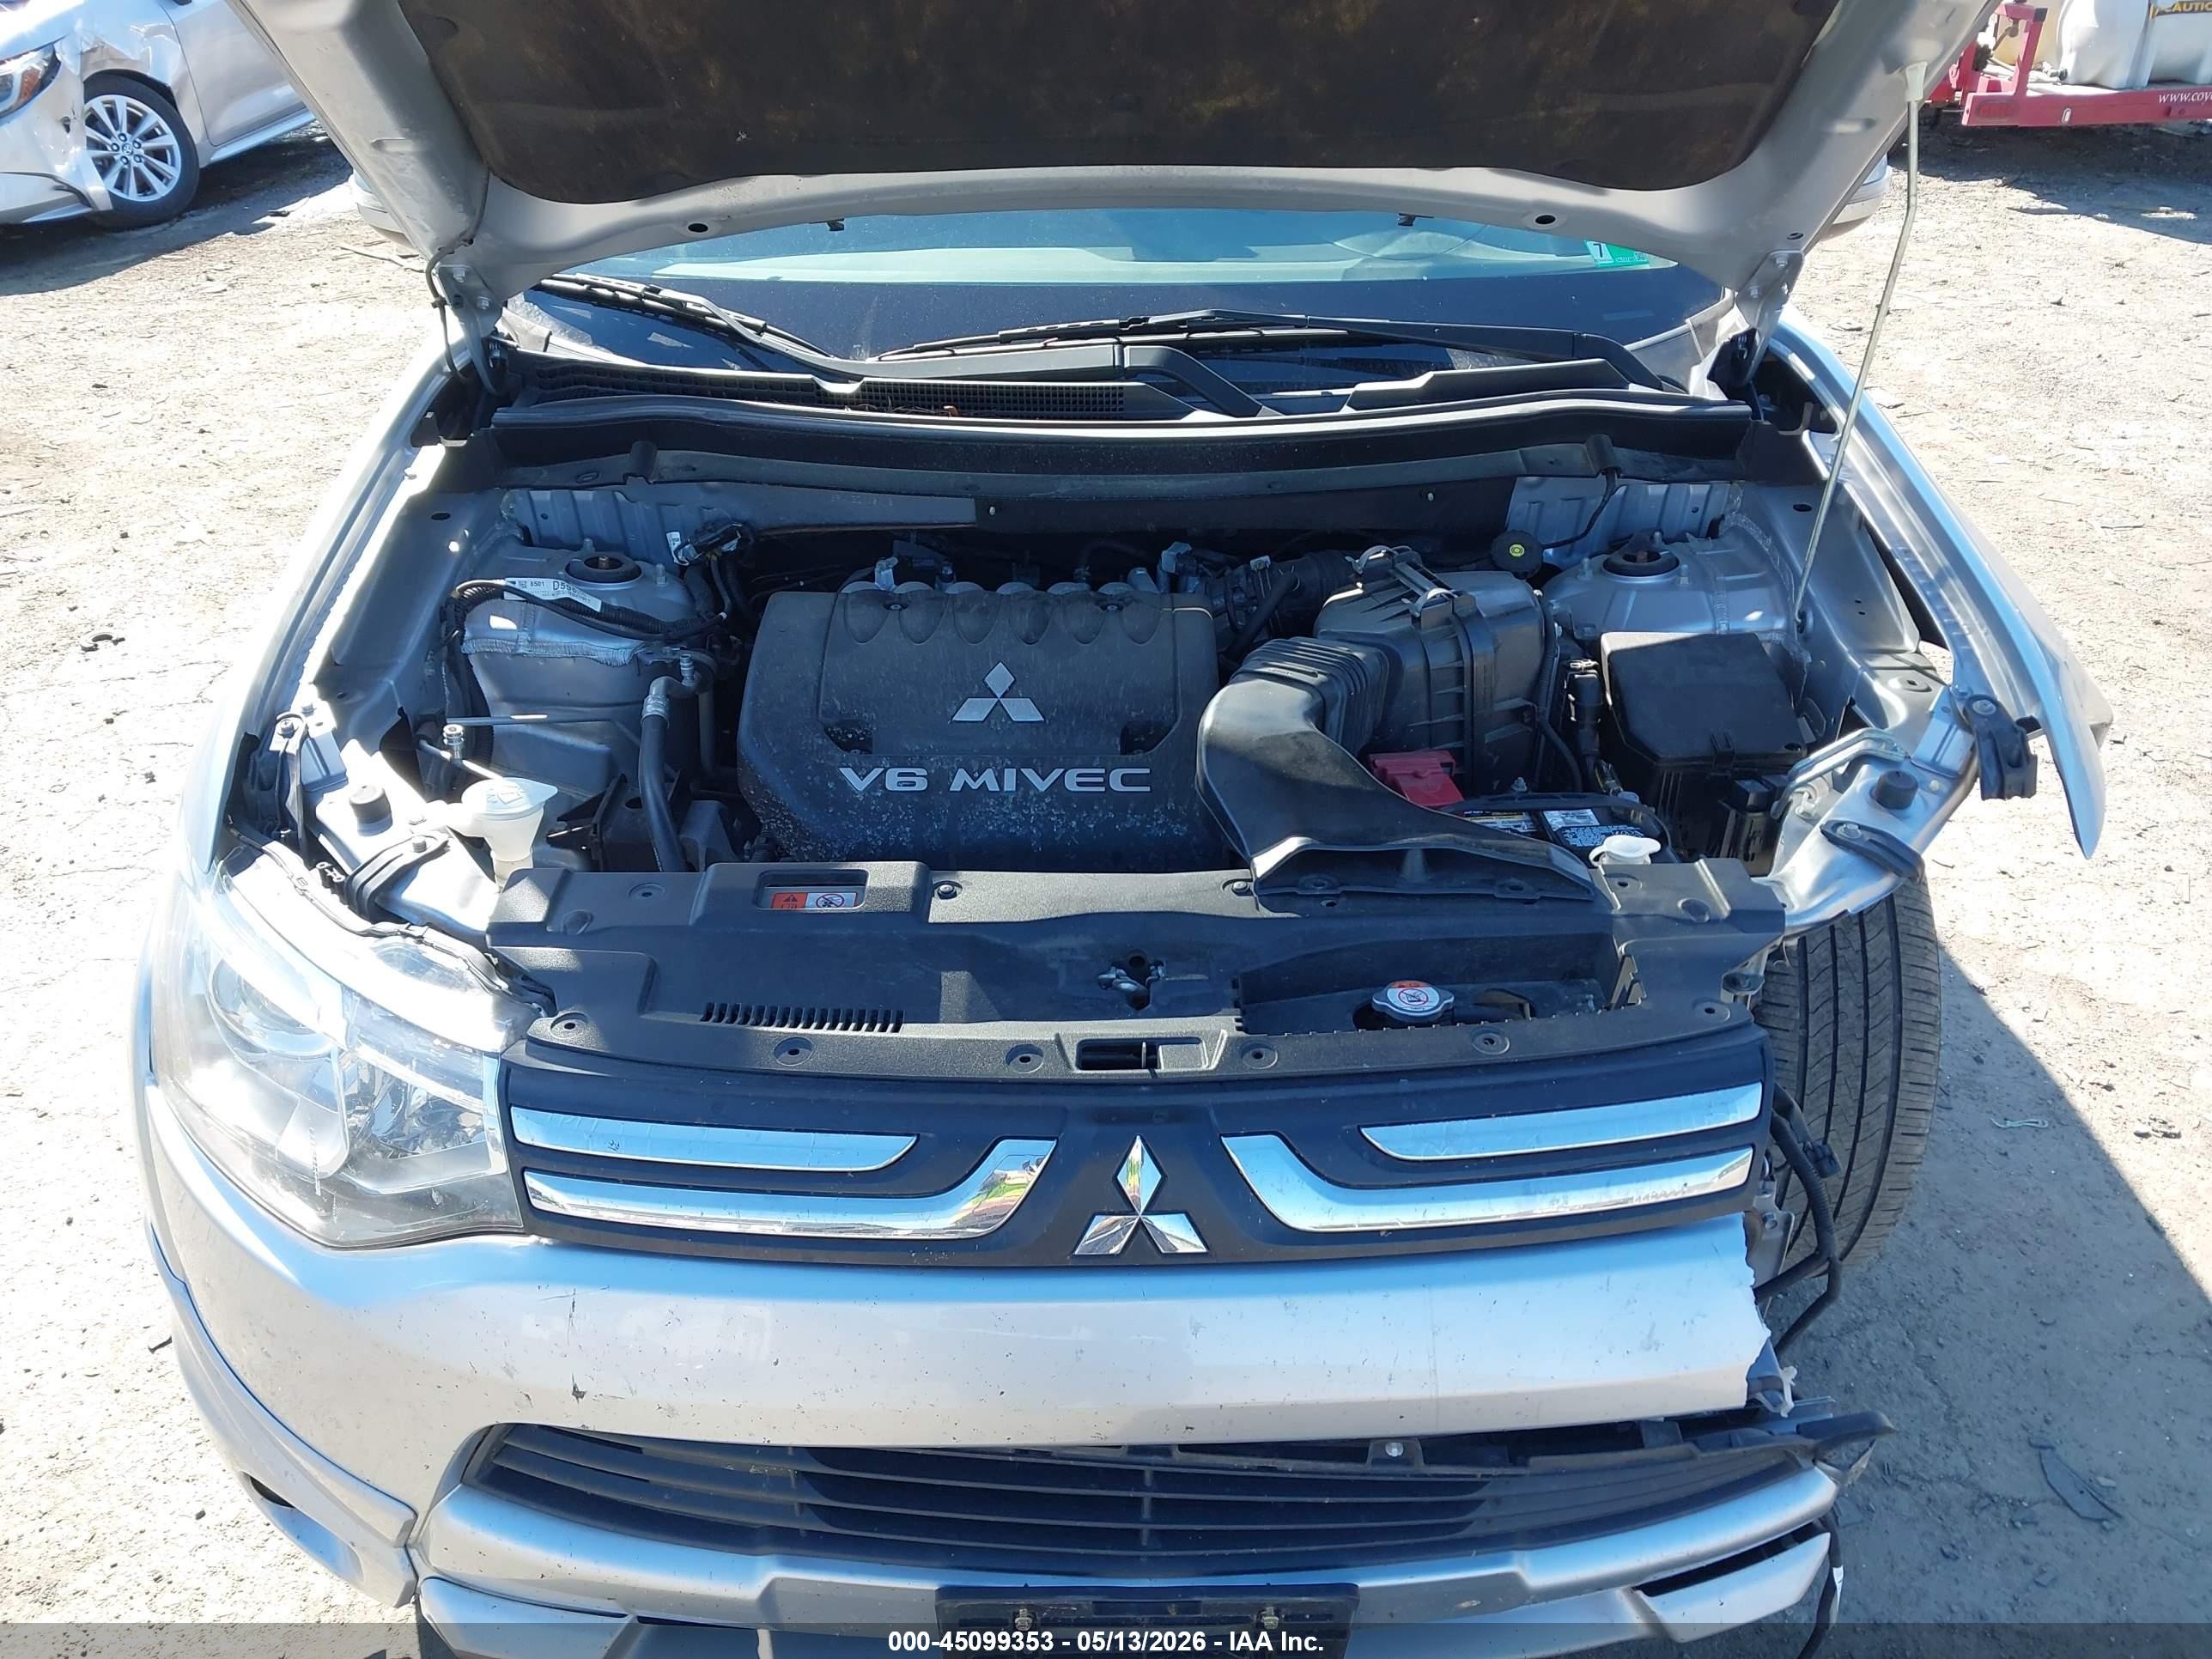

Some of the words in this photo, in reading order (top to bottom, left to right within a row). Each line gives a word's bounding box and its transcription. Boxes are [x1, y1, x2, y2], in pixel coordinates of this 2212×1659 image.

[1593, 243, 1603, 258] 7
[839, 768, 928, 792] V6
[950, 768, 1151, 792] MIVEC
